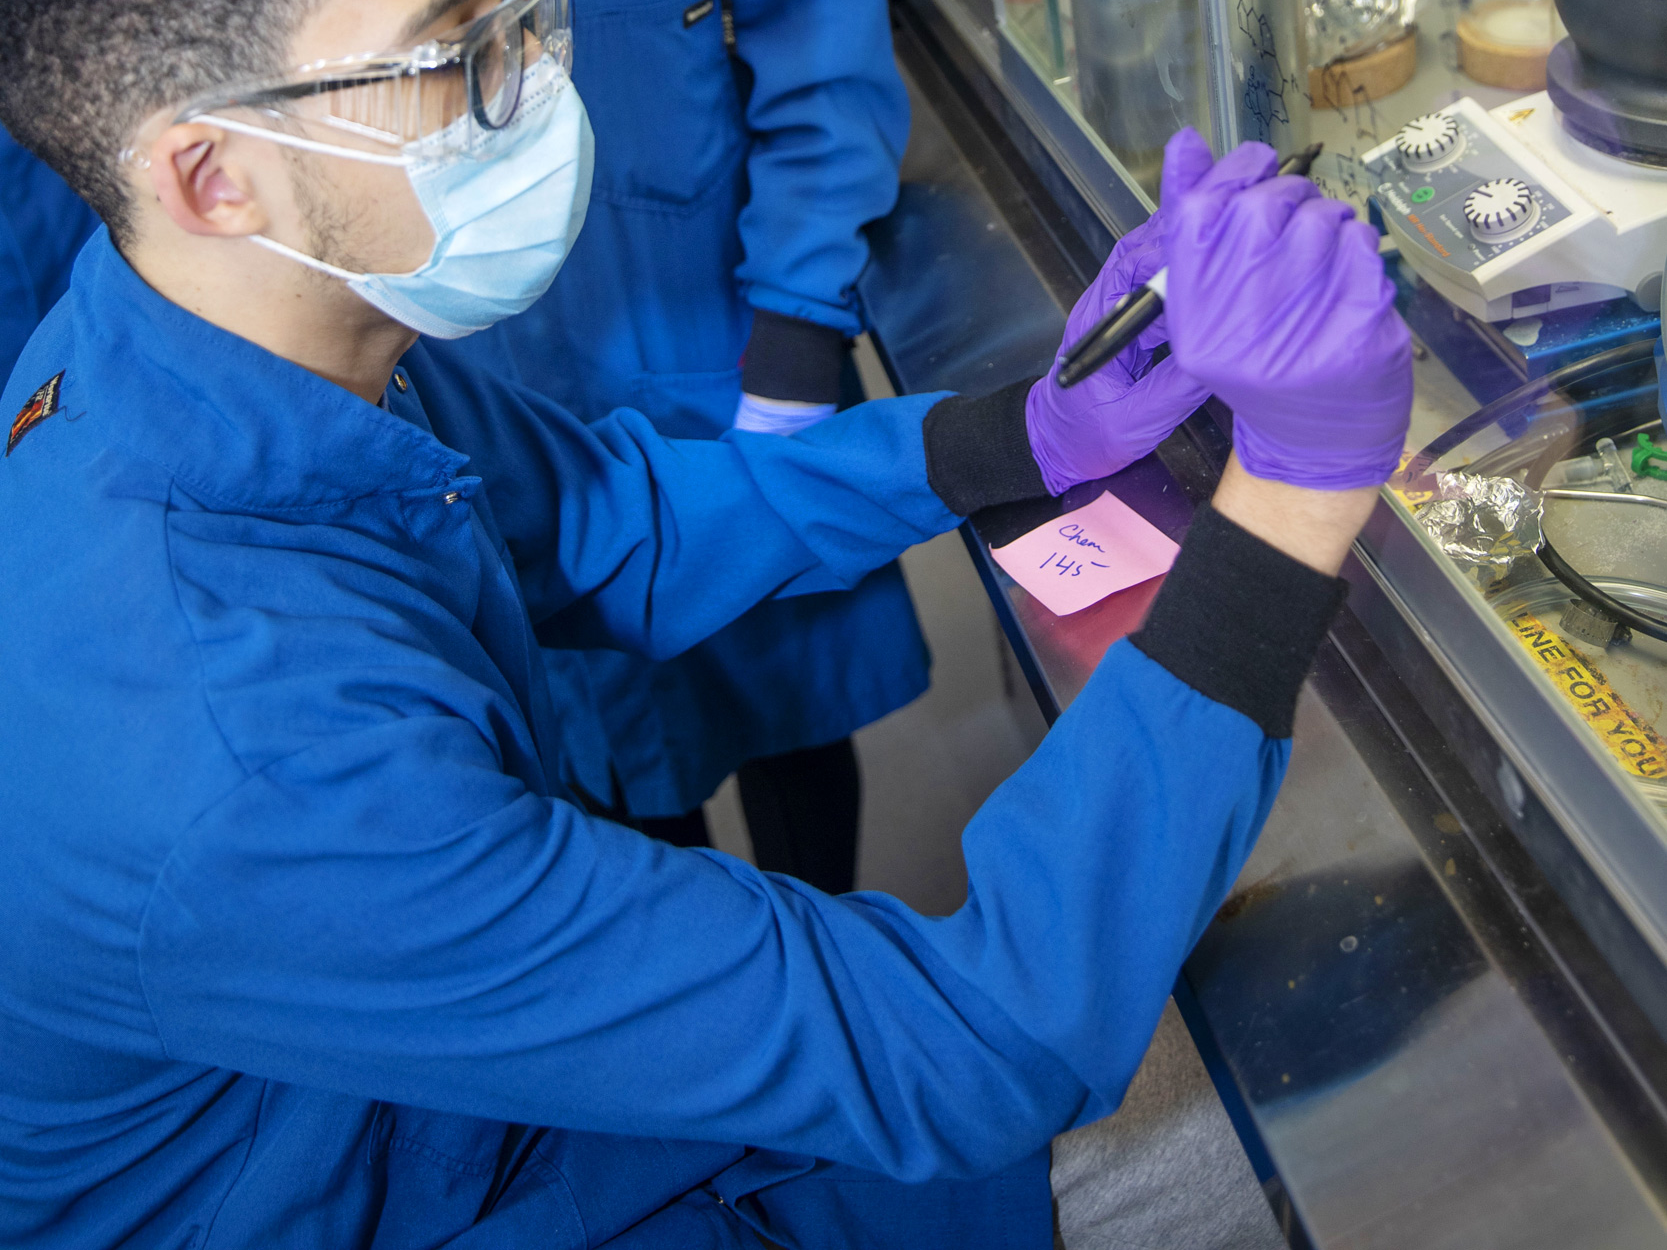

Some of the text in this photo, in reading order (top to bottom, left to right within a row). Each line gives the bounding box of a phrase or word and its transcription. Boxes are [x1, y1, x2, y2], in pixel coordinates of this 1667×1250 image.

[1058, 523, 1106, 554] Chem
[1511, 611, 1566, 664] LINE
[1559, 666, 1612, 718] FOR
